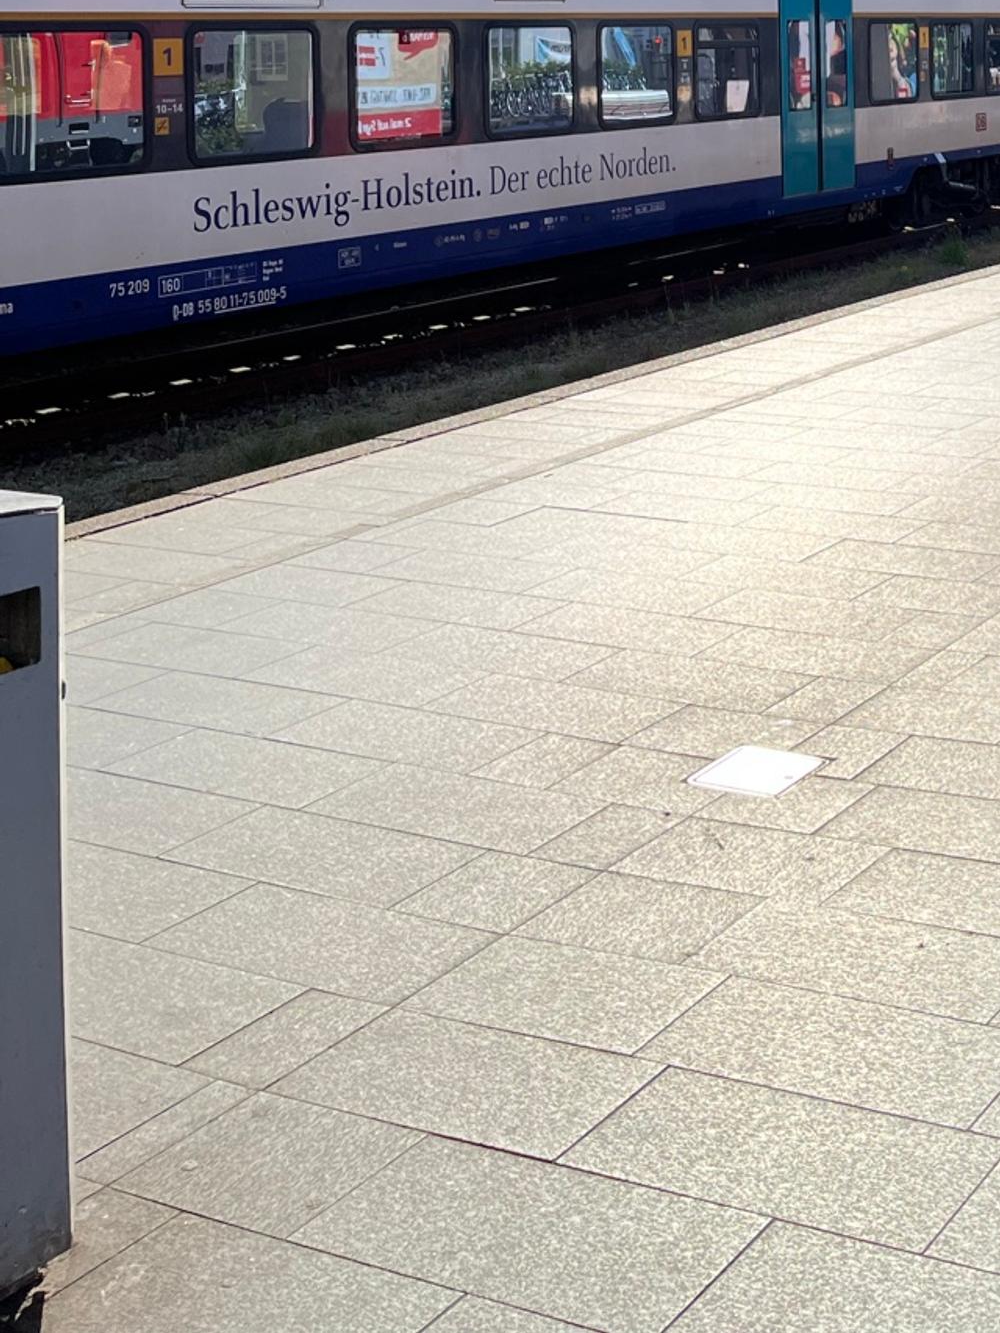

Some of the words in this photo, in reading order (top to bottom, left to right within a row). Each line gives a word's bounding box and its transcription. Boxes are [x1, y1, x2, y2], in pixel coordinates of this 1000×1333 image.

[162, 47, 172, 67] 1
[193, 169, 482, 233] Schleswig-Holstein.
[490, 166, 529, 195] Der
[536, 155, 592, 189] echte
[599, 146, 677, 181] Norden.
[109, 282, 125, 298] 75
[127, 279, 150, 295] 209
[161, 277, 181, 294] 160
[199, 299, 212, 314] 55
[214, 296, 228, 310] 80
